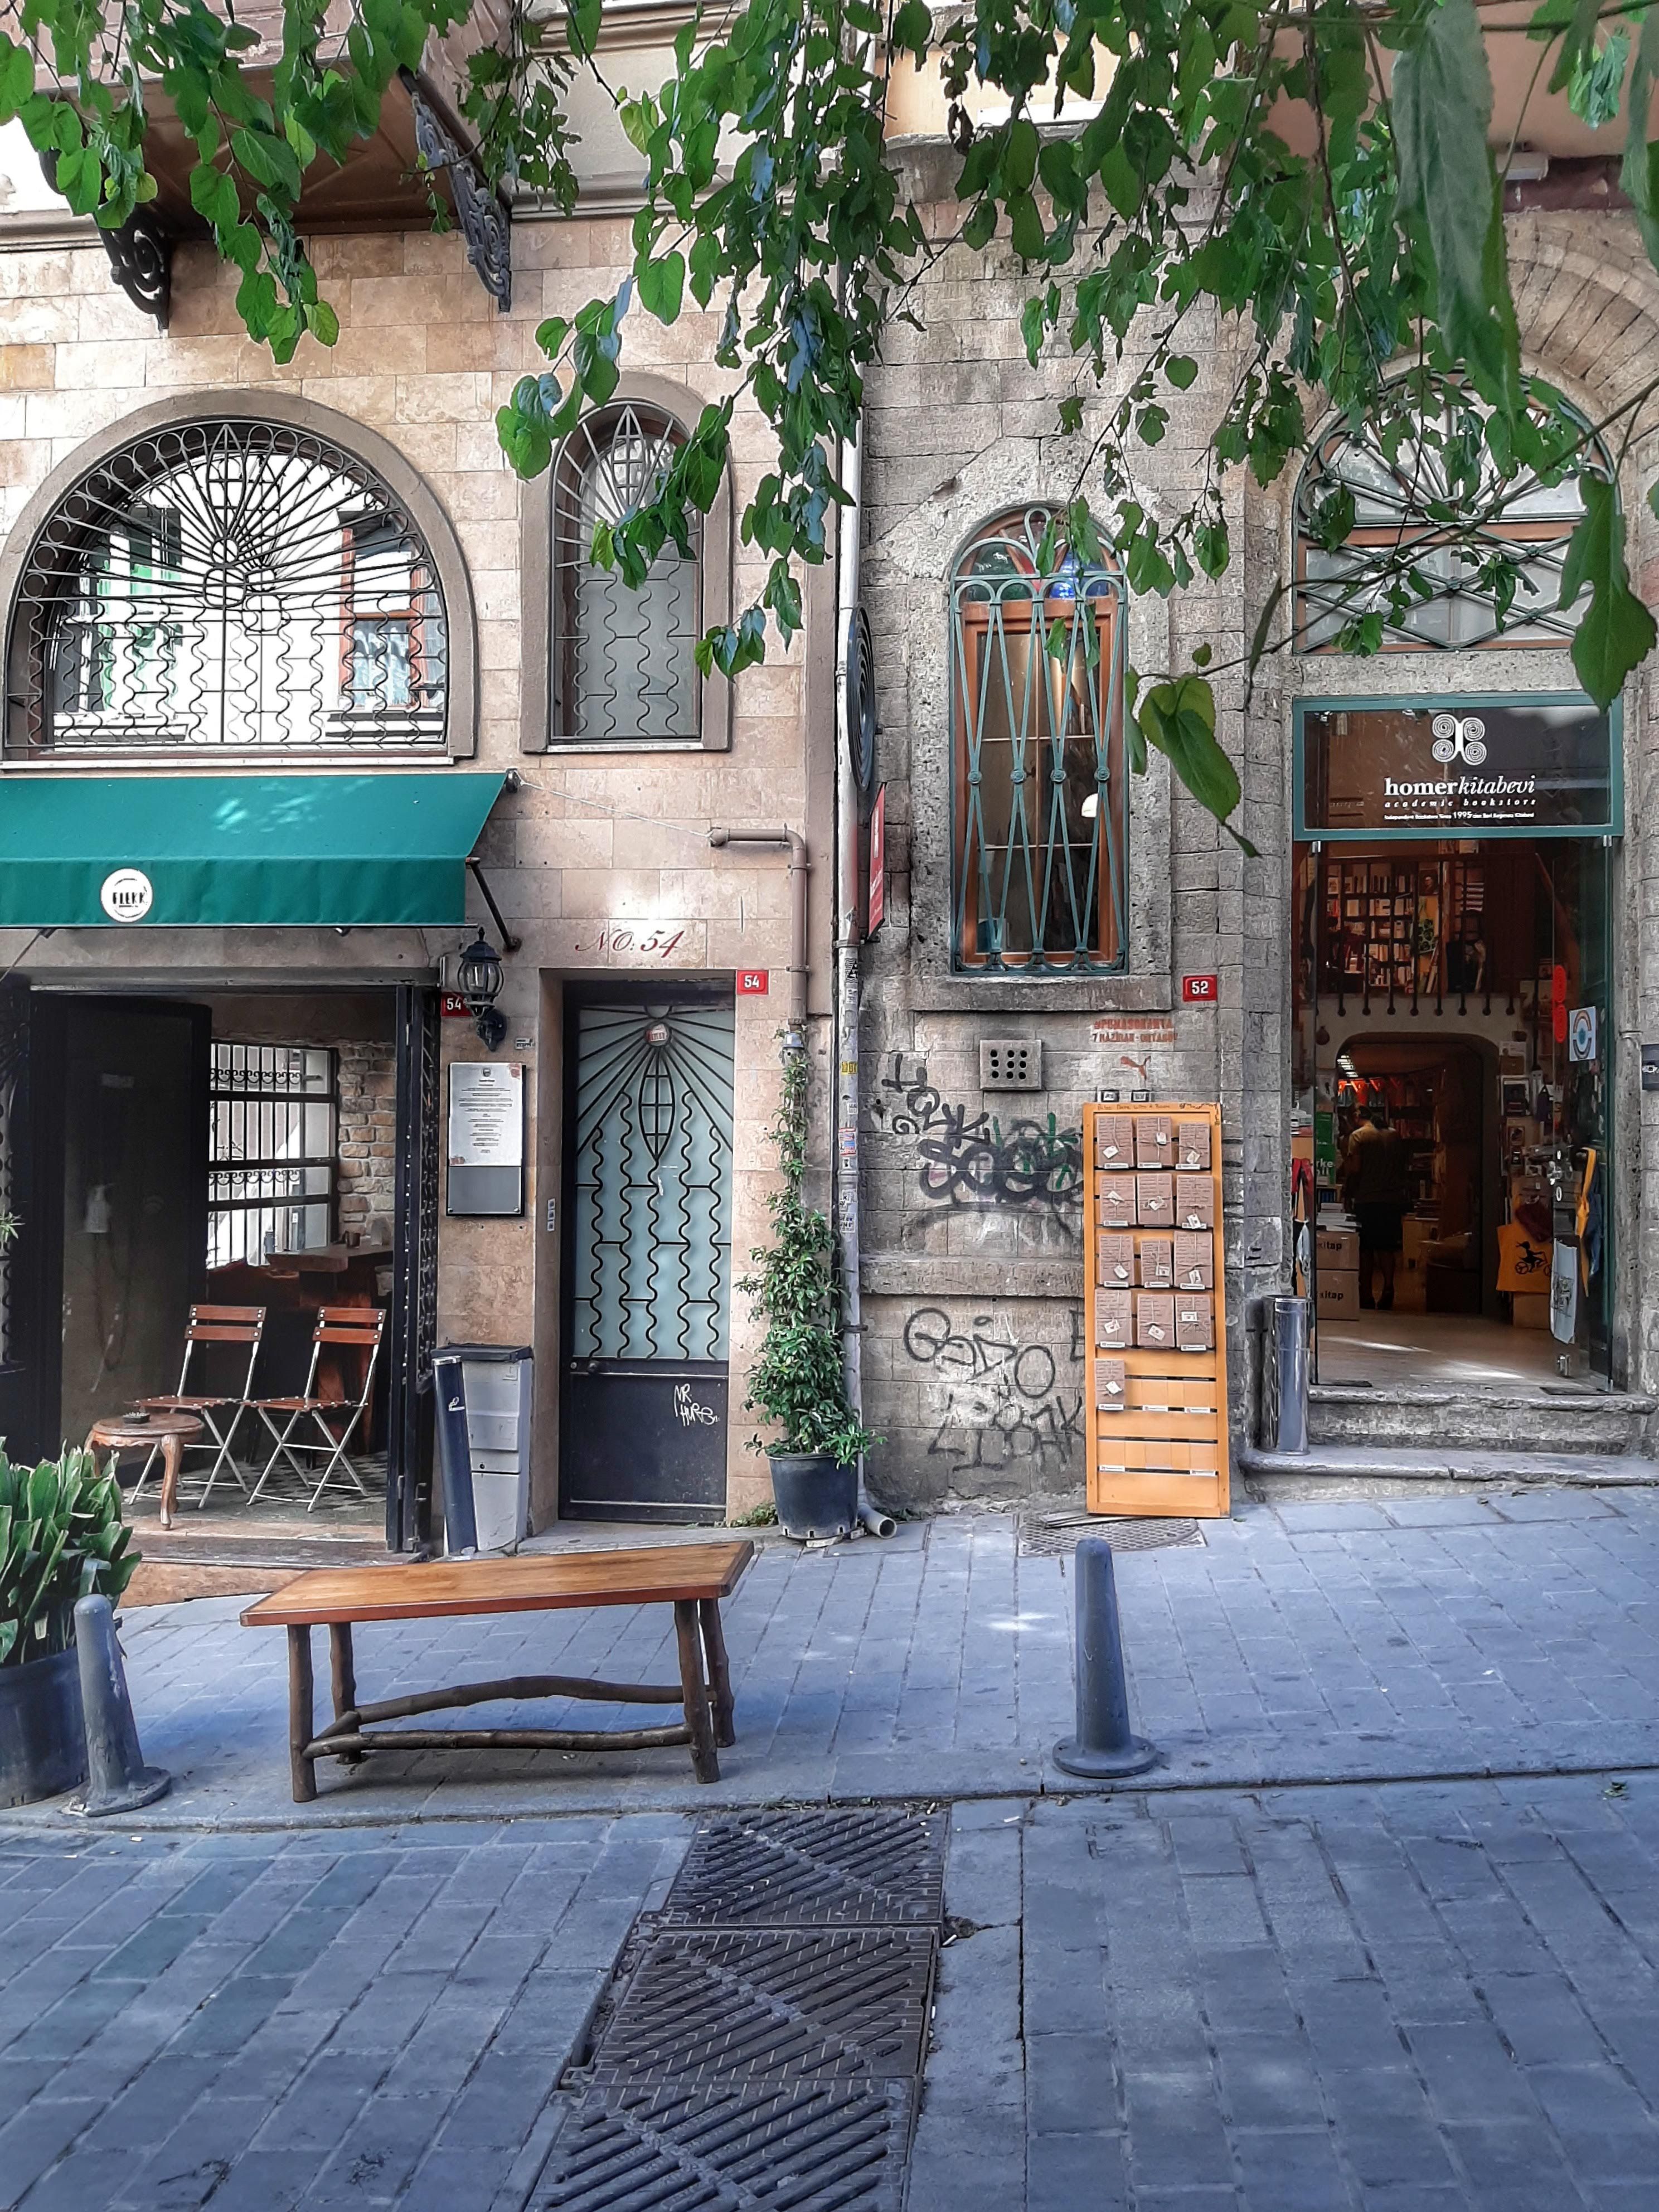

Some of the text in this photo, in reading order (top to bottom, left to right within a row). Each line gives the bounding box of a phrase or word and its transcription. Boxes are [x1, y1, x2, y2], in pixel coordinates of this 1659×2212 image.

[1384, 798, 1536, 808] academic bookstore
[641, 930, 685, 958] 54
[744, 975, 760, 988] 54
[1192, 981, 1209, 995] 52
